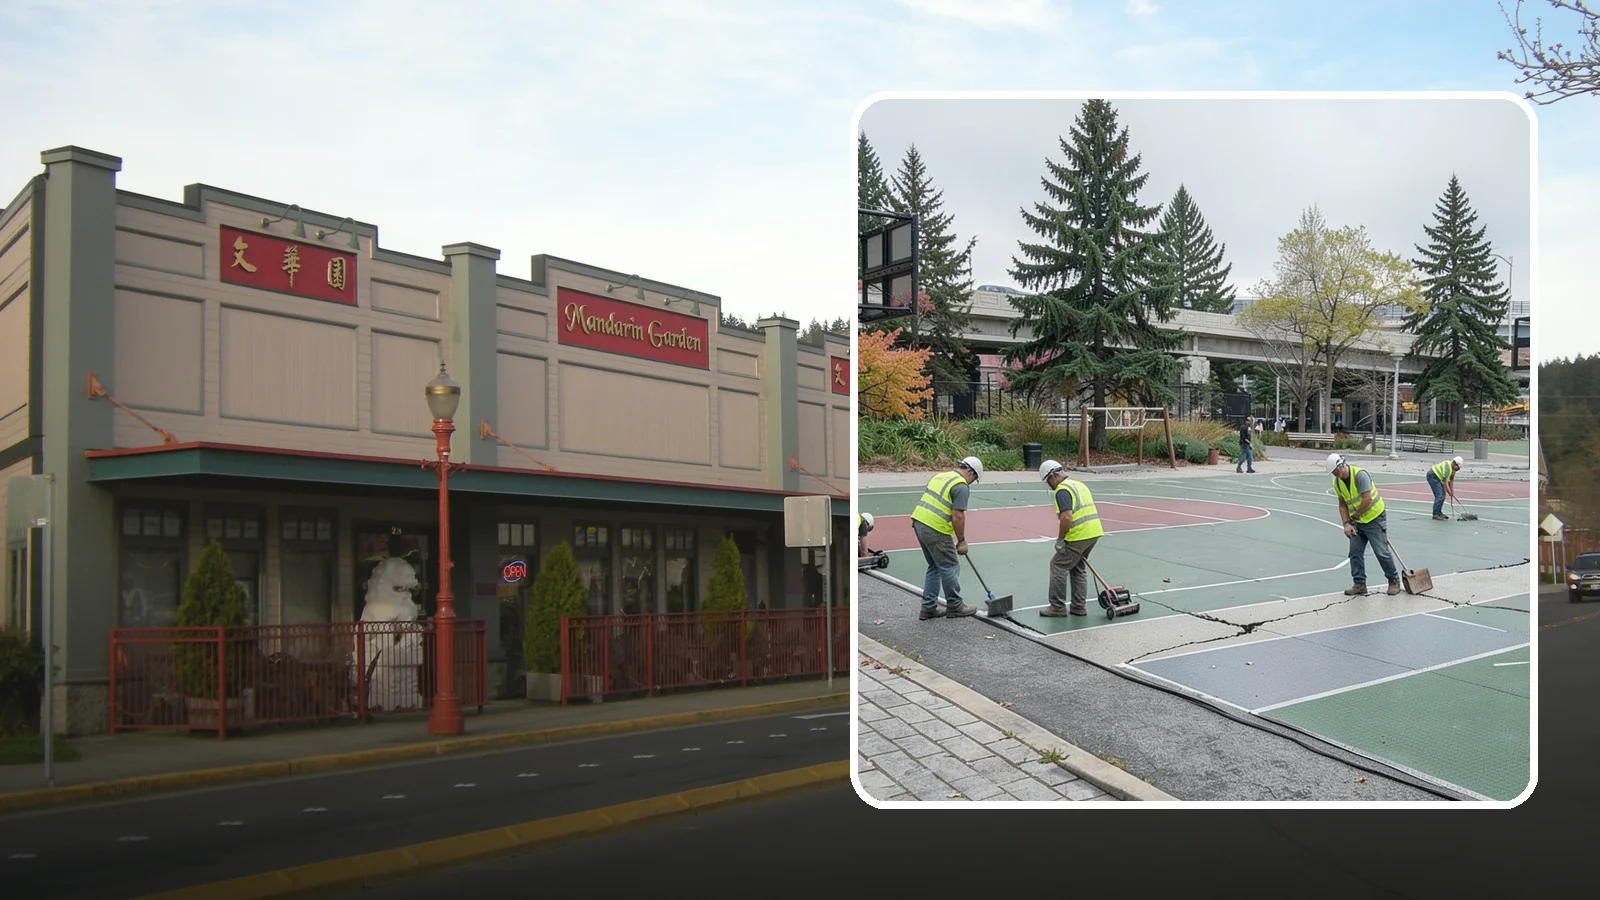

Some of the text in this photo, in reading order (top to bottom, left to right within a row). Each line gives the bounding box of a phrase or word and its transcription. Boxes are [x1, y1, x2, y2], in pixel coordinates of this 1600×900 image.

[231, 236, 346, 290] 文華園
[564, 302, 701, 352] Mandarin Garden
[834, 363, 846, 386] 文
[503, 565, 527, 578] OPEN
